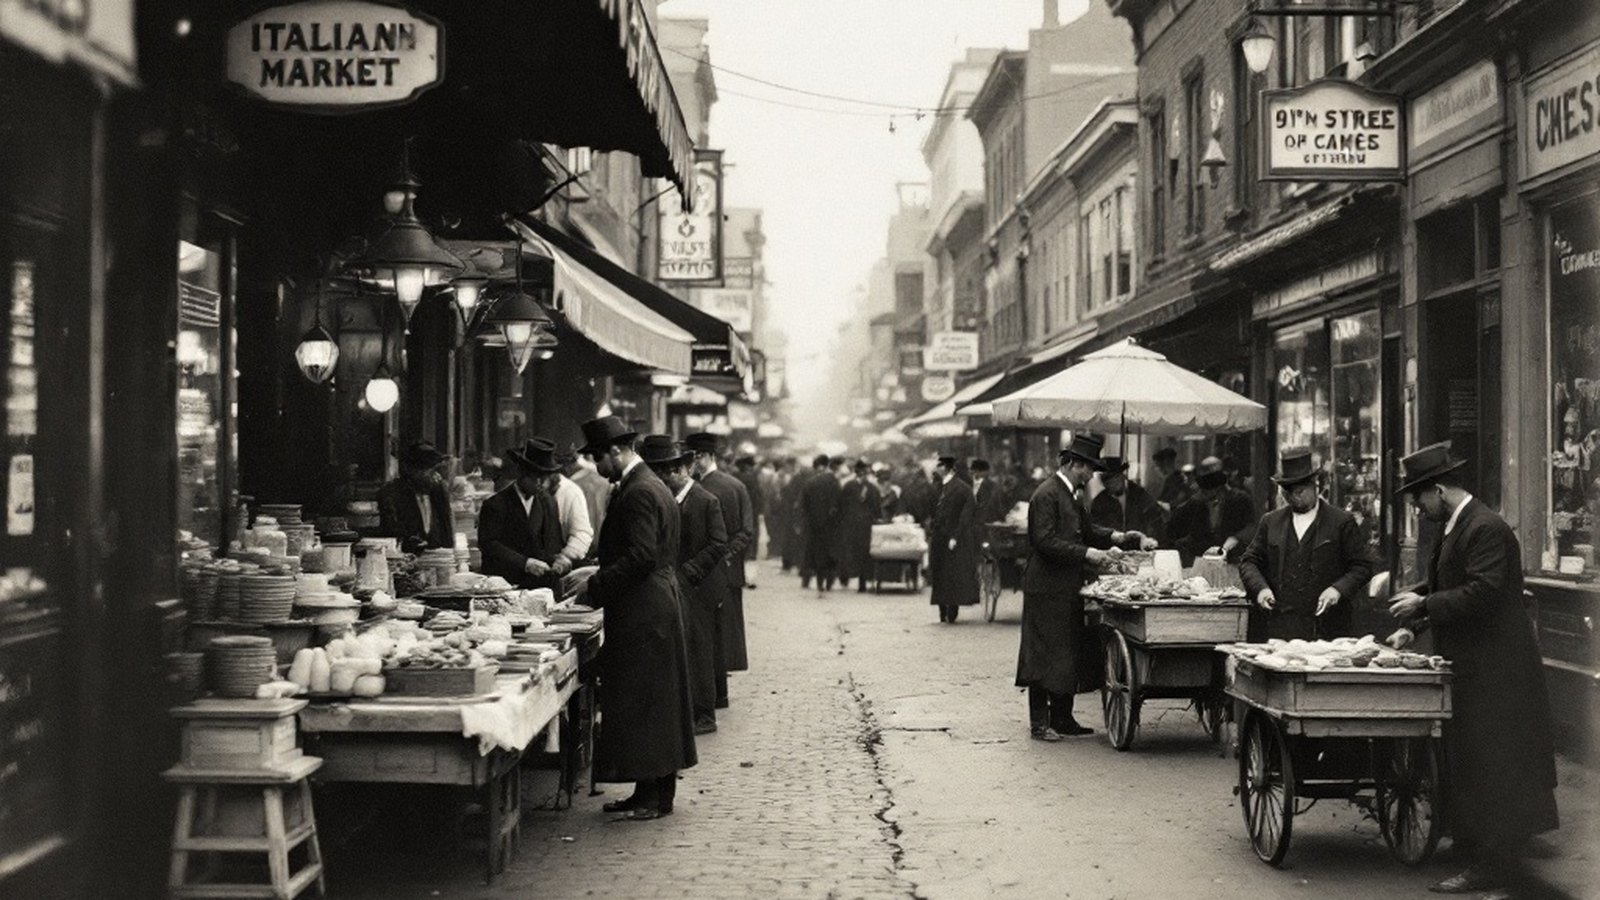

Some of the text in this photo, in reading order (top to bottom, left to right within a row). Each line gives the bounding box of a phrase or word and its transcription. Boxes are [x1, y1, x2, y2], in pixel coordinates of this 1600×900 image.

[260, 58, 400, 87] MARKET
[1324, 109, 1395, 130] STREE
[1536, 74, 1600, 152] CHES
